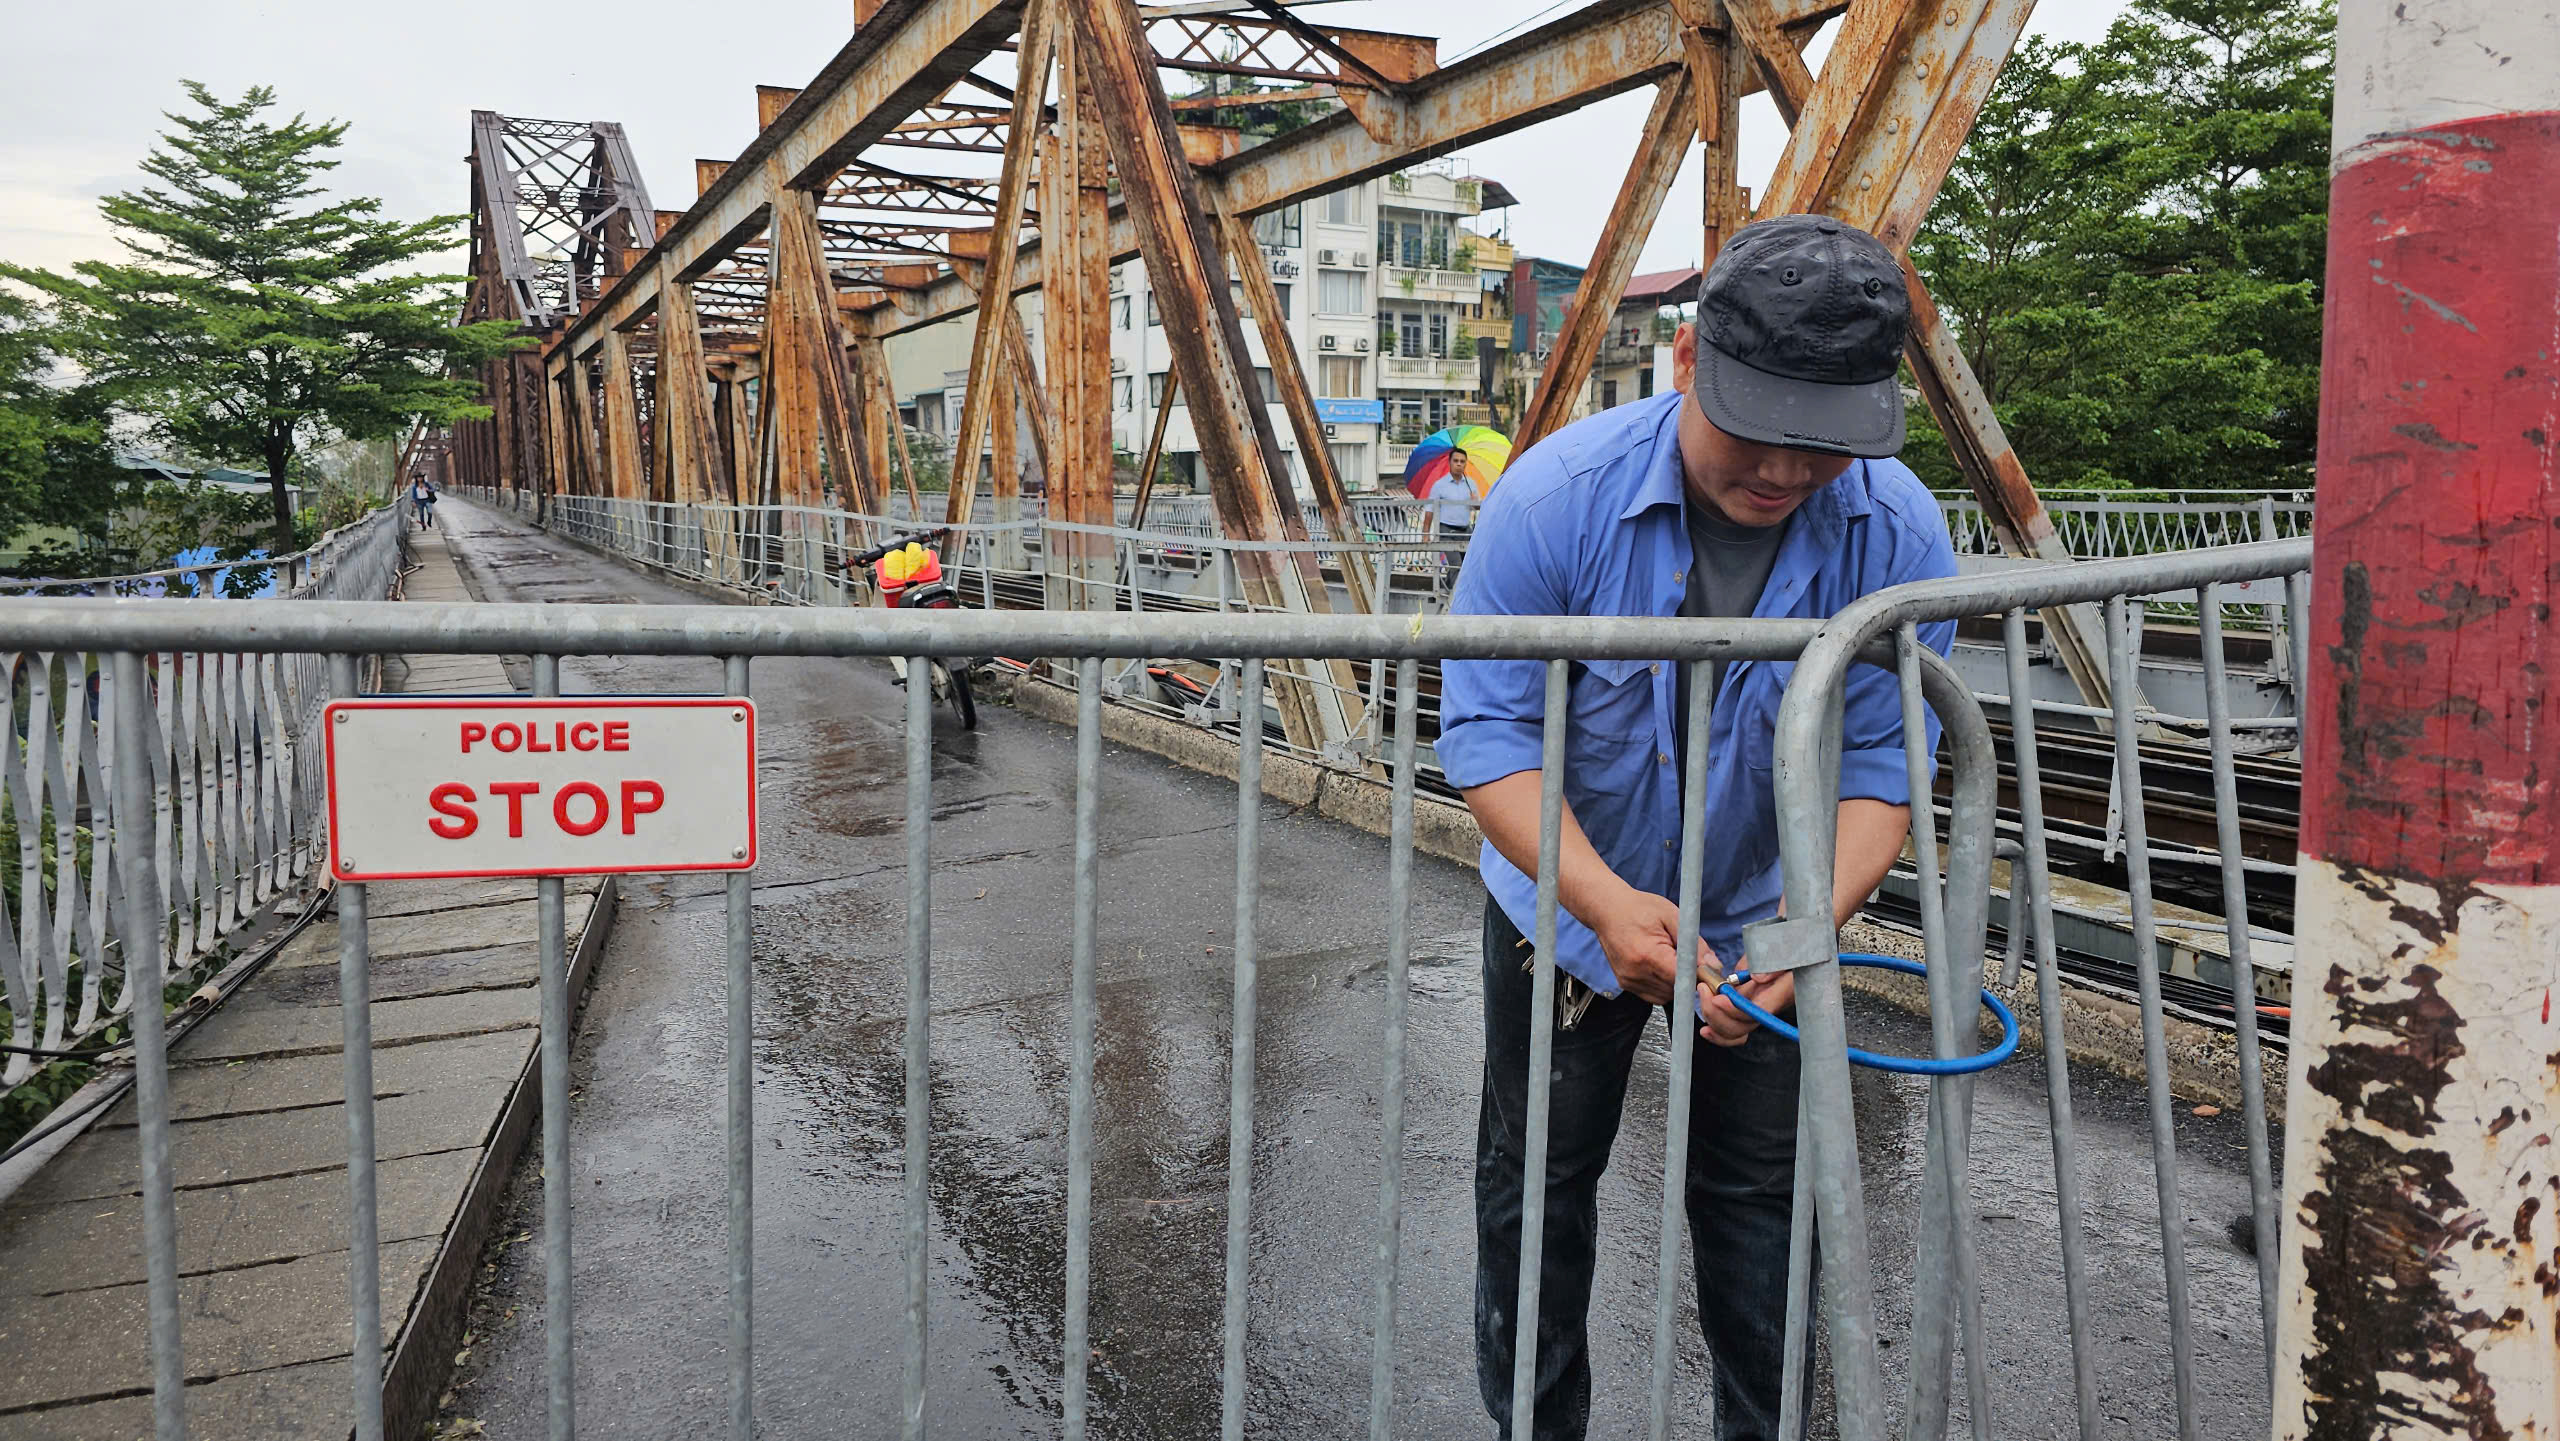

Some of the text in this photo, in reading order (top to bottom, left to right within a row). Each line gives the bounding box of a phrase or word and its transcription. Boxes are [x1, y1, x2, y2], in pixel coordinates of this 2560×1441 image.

[1273, 260, 1299, 277] Coffee
[460, 721, 630, 753] POLICE
[428, 779, 665, 839] STOP
